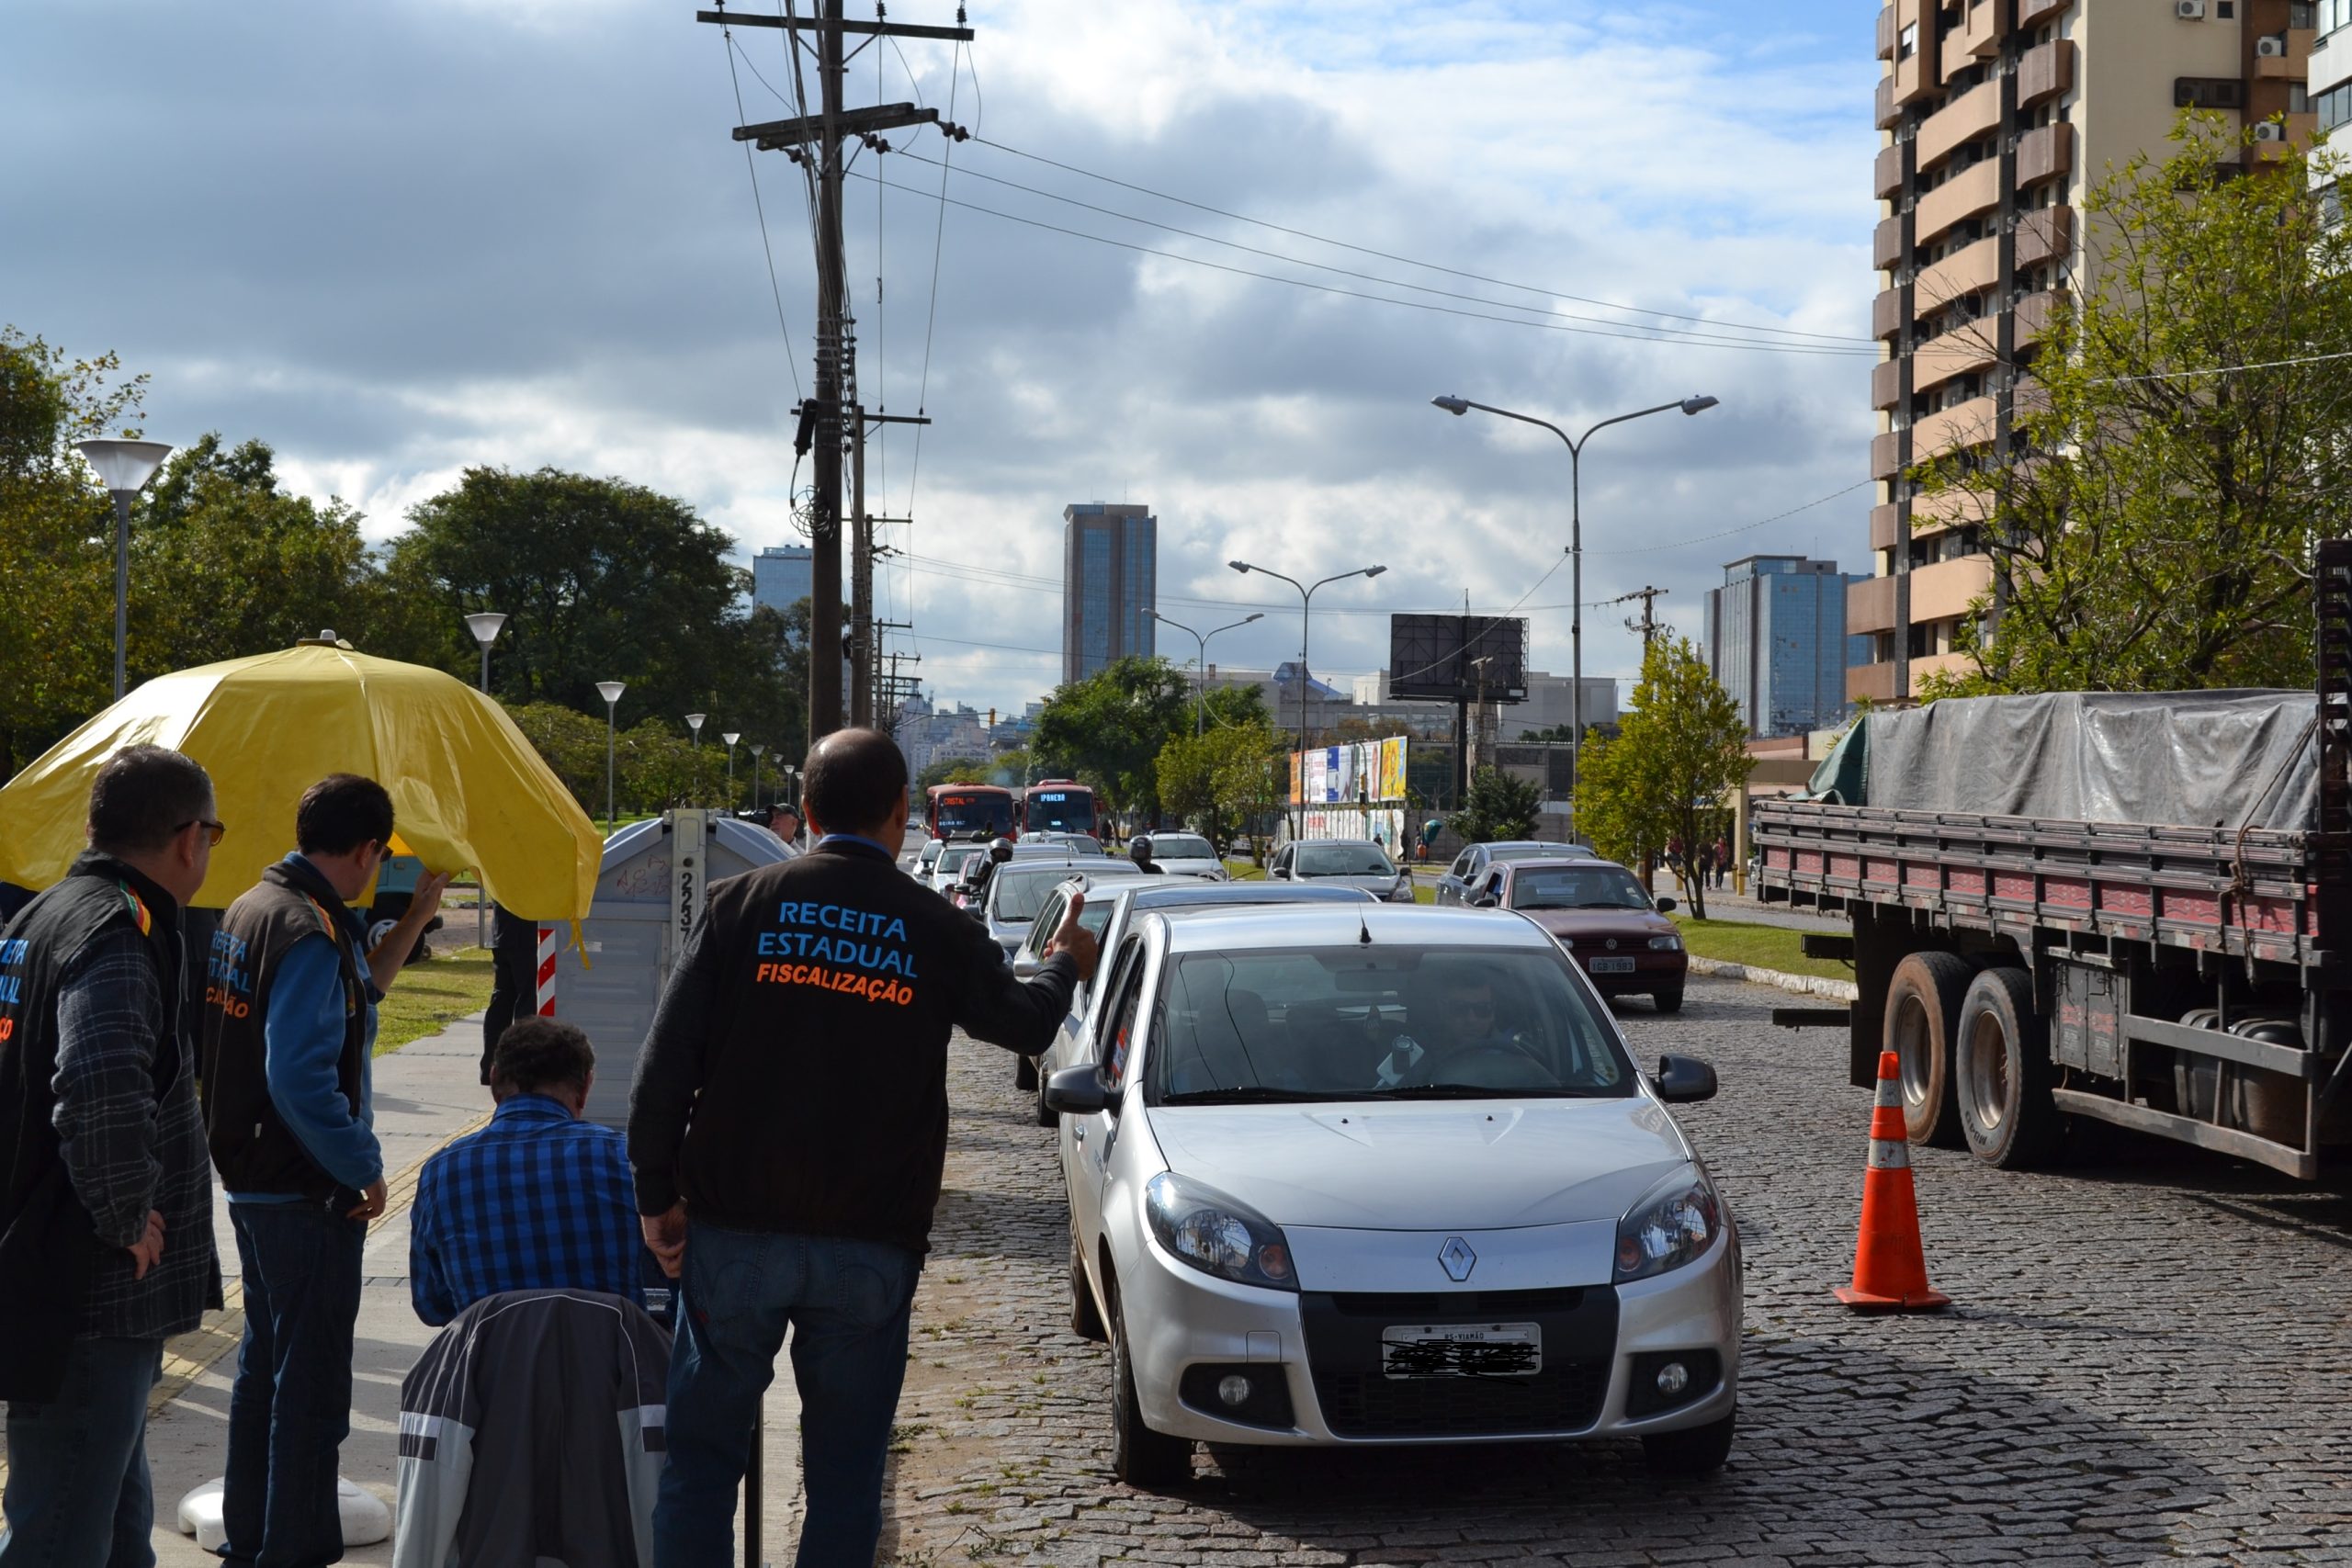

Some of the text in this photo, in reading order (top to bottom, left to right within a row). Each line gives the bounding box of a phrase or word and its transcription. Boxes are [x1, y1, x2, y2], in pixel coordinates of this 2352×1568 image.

[779, 902, 907, 942] RECEITA
[757, 932, 918, 978] ESTADUAL
[756, 964, 912, 1005] FISCALIZAÇÃO
